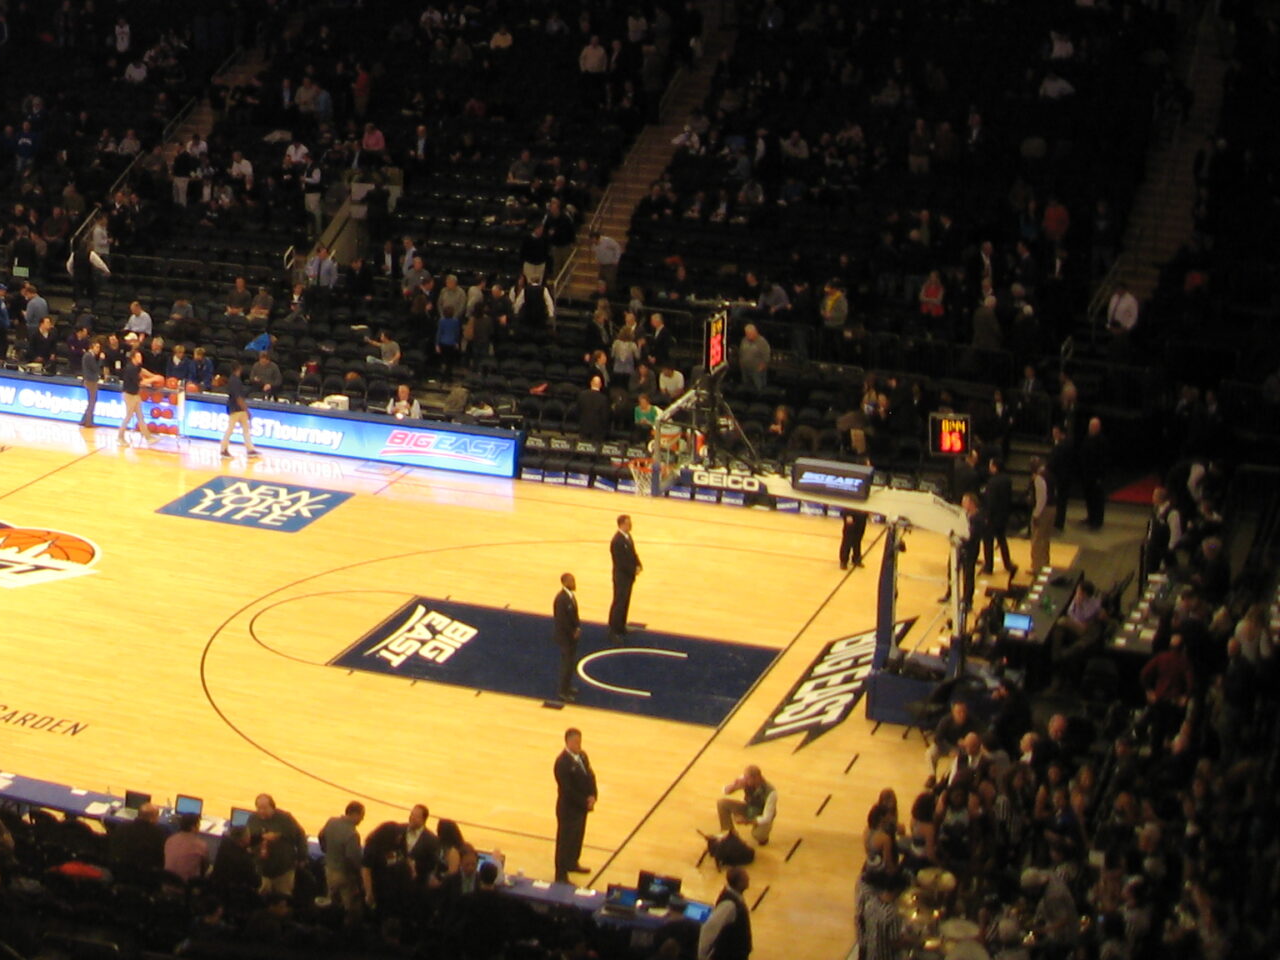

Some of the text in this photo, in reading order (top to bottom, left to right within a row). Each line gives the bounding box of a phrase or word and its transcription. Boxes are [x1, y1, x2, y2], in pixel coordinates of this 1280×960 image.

[219, 481, 332, 504] NEW
[693, 471, 760, 491] GEICO
[188, 499, 289, 526] LIFE
[201, 488, 326, 518] YORK
